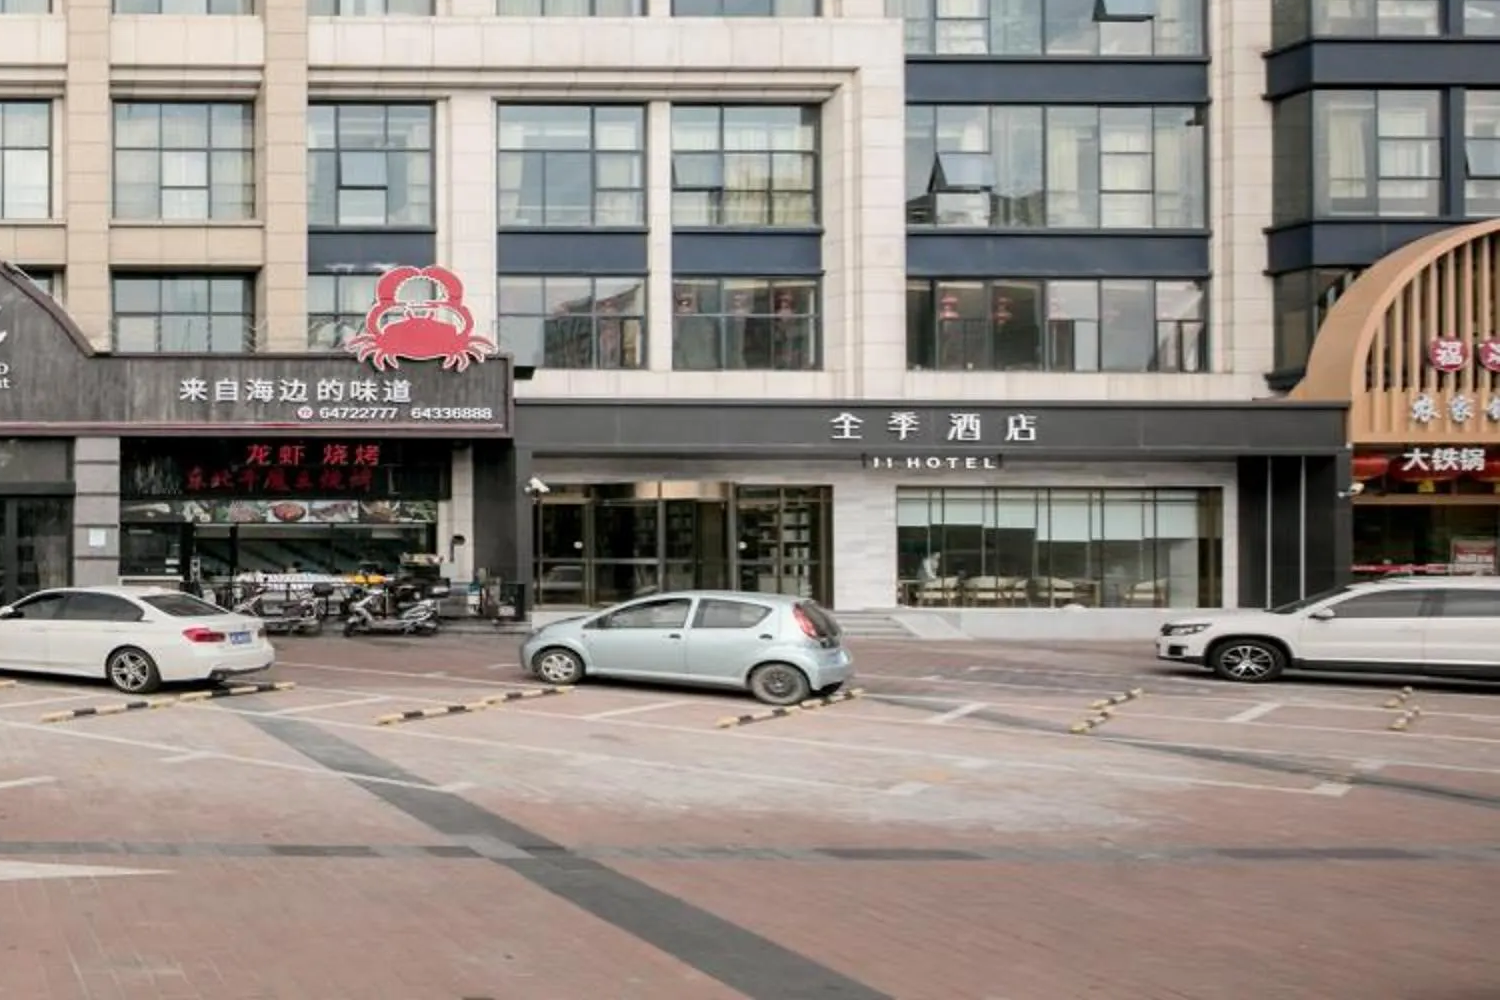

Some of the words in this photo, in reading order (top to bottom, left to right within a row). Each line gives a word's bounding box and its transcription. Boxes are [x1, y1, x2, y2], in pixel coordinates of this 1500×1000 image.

[179, 377, 413, 403] 来自海边的味道
[319, 406, 399, 420] 64722777
[829, 411, 1038, 442] 全季酒店
[907, 456, 997, 469] HOTEL
[1401, 447, 1486, 471] 大铁锅
